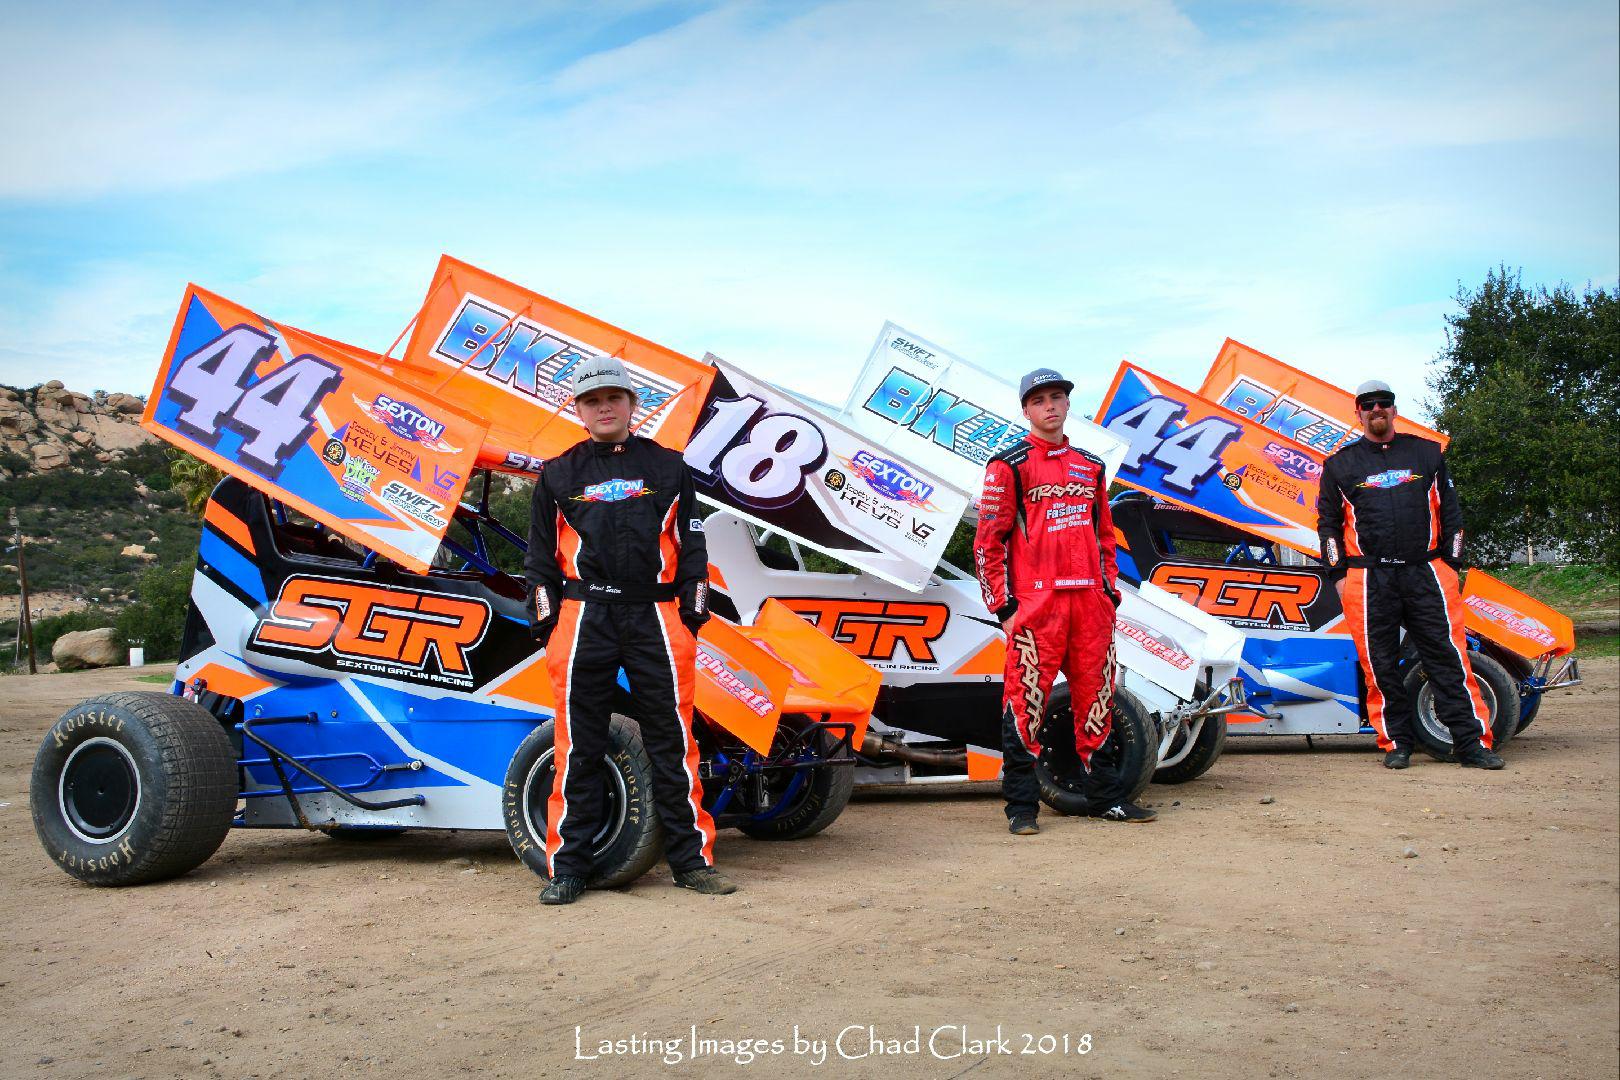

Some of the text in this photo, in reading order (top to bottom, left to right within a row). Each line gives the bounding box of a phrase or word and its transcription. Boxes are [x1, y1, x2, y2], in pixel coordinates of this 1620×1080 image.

[436, 298, 570, 398] BK
[168, 323, 344, 482] 44
[376, 396, 444, 438] SEXTON
[863, 366, 986, 452] BK
[1220, 379, 1324, 441] BK
[344, 431, 412, 475] KEYES
[683, 393, 828, 509] 18
[1104, 395, 1245, 498] 44
[386, 482, 441, 512] SWIFT
[586, 480, 643, 497] SEXTON
[854, 452, 930, 499] SEXTON
[1028, 481, 1097, 503] TRAXXAS
[1366, 469, 1410, 483] SEXTON
[254, 577, 489, 674] SGR
[336, 659, 474, 688] SEXTON GATLIN RACING
[53, 711, 127, 748] Hoosier
[58, 835, 136, 871] Hoosier
